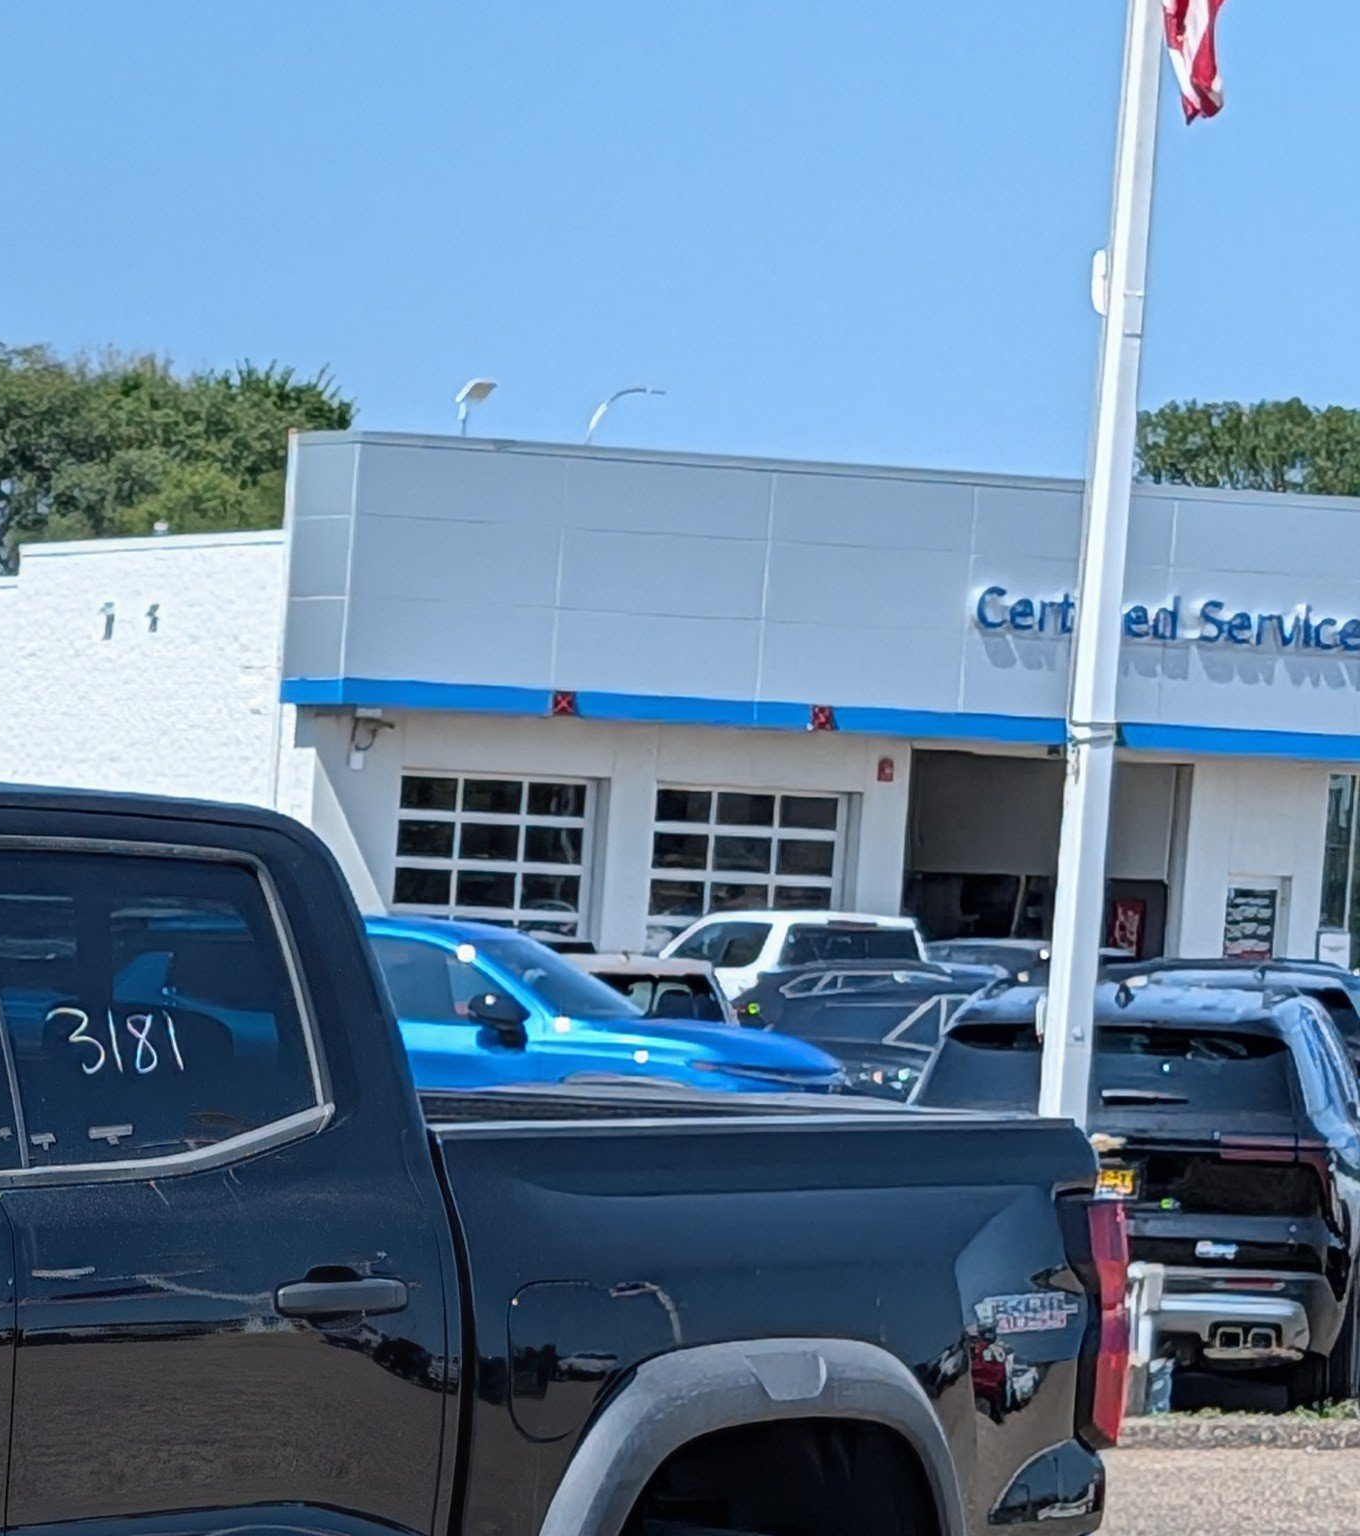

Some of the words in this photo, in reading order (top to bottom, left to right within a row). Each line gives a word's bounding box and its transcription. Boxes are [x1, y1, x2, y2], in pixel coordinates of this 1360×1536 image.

[976, 585, 1182, 640] Certed
[1198, 599, 1360, 651] Service
[45, 1006, 185, 1076] 3181
